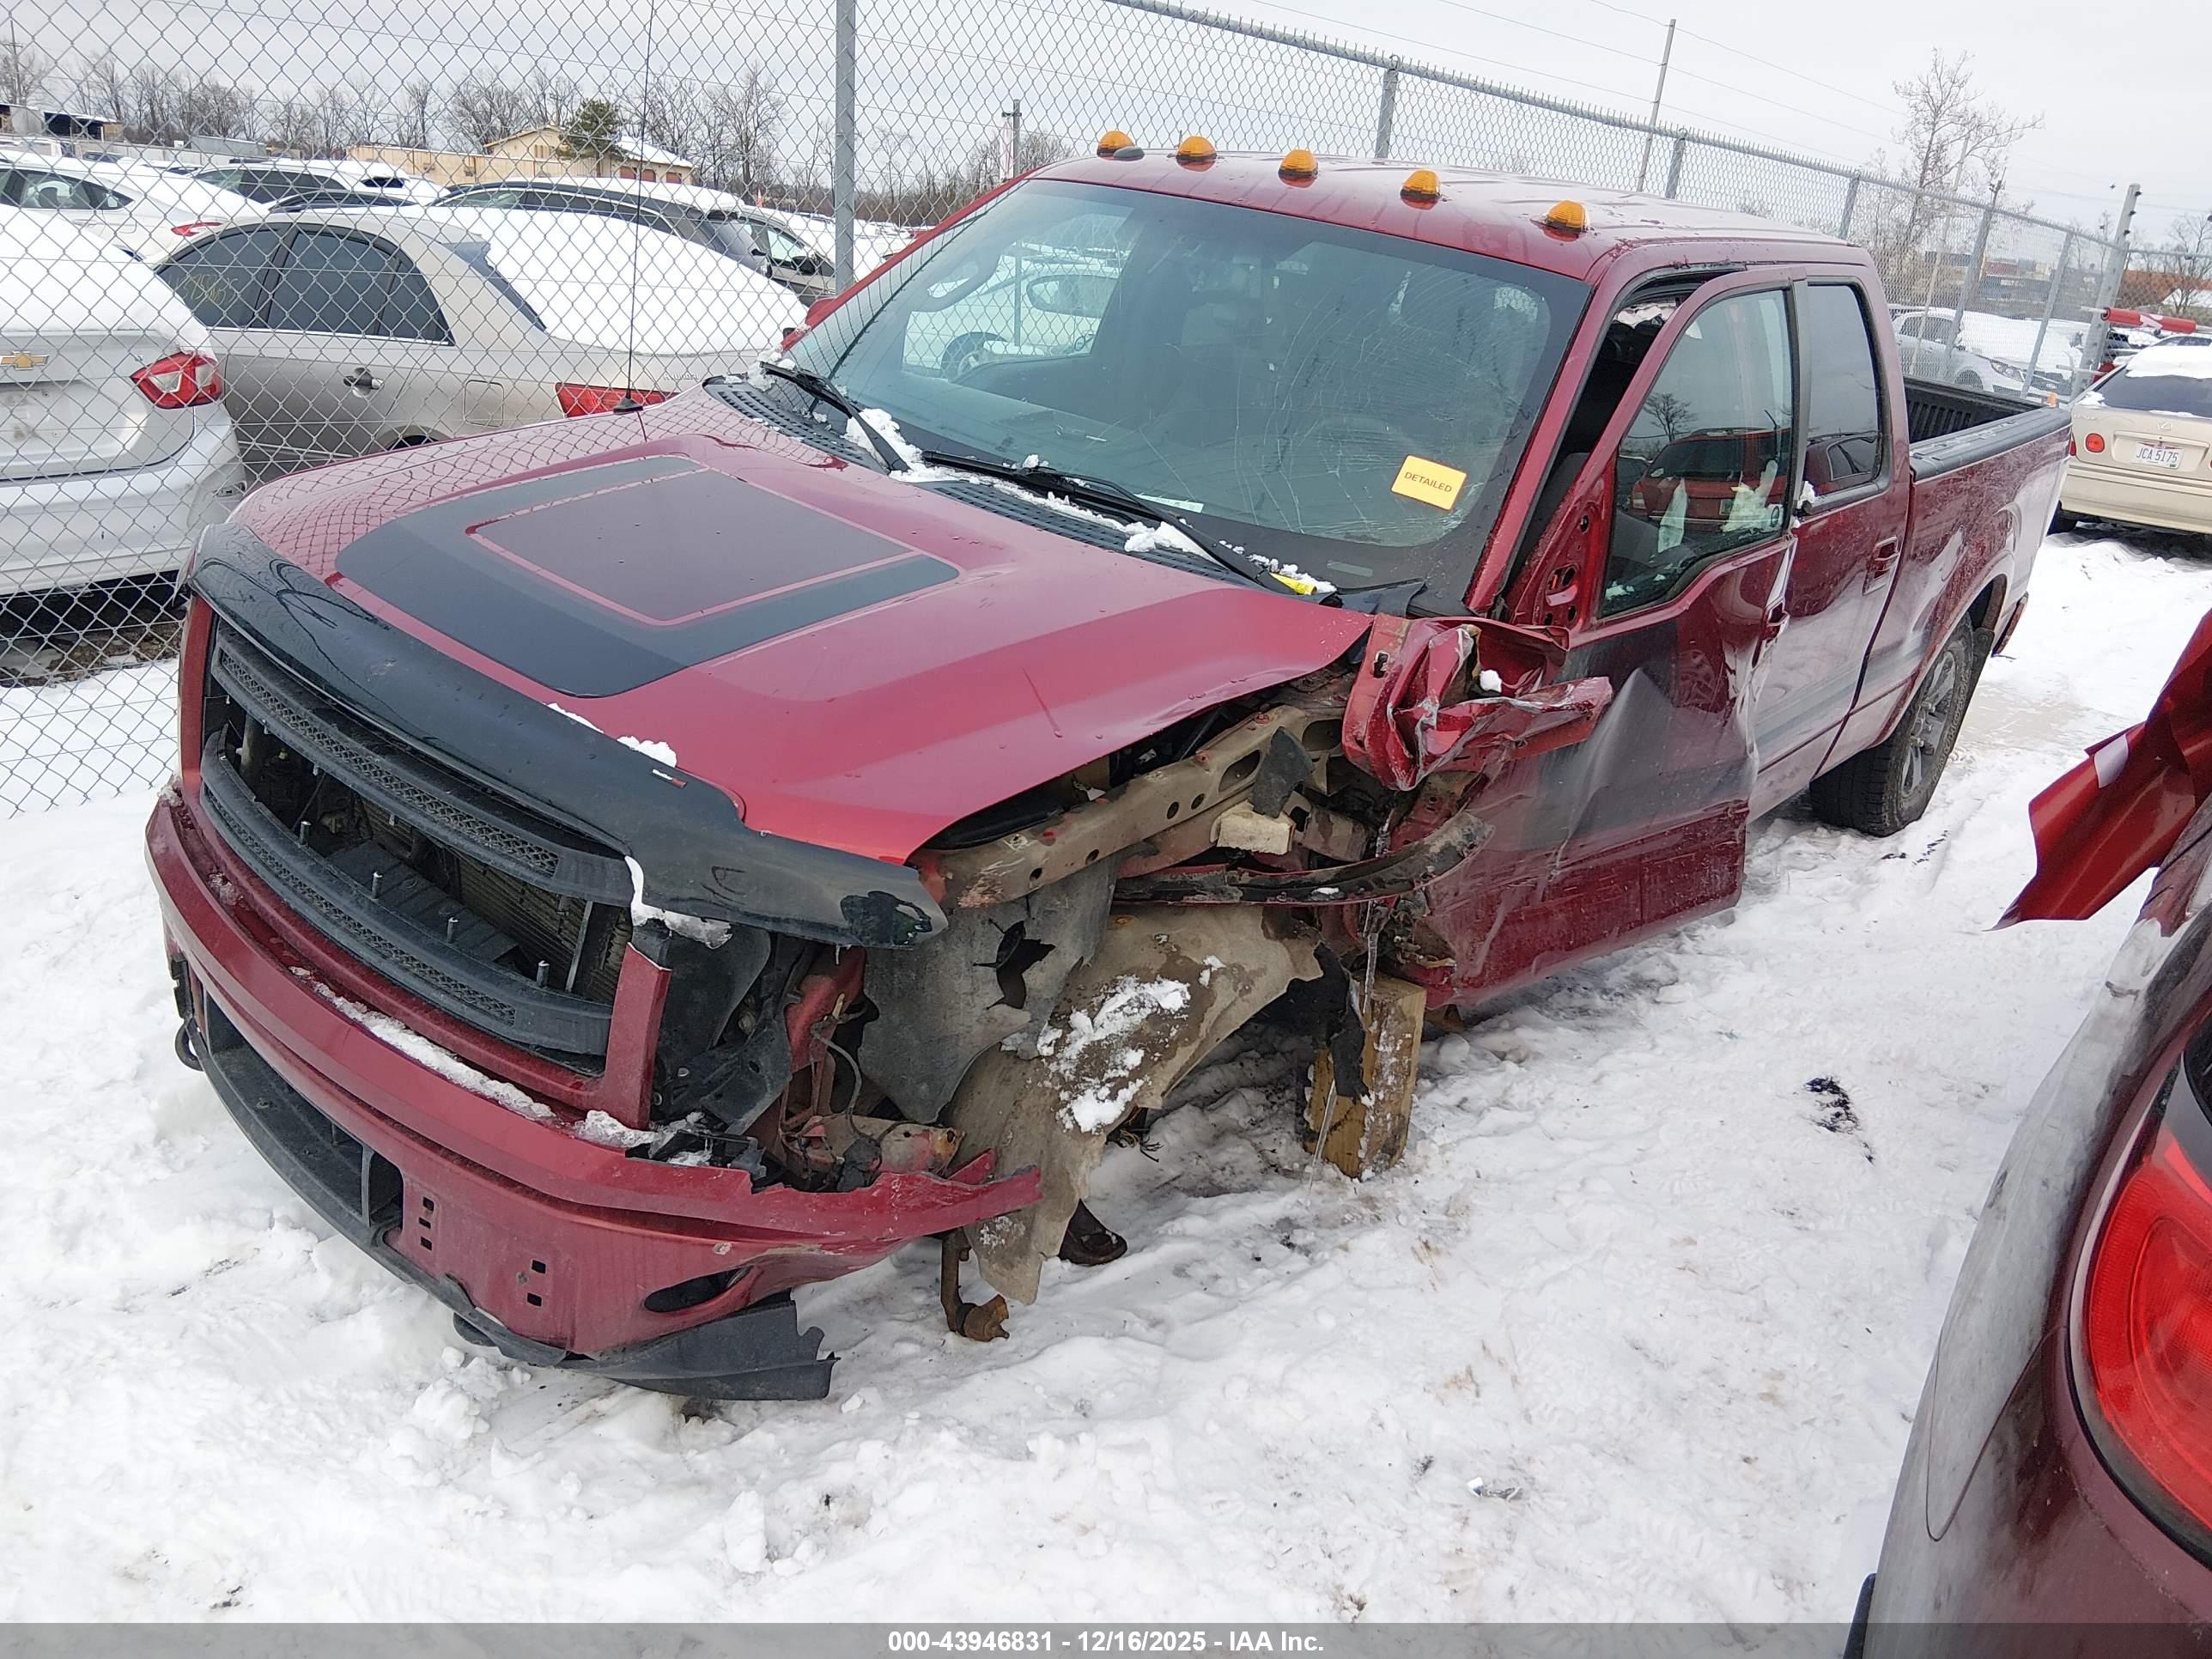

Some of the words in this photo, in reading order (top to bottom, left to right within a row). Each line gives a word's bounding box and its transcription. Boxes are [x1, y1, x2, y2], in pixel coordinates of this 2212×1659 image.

[2136, 447, 2153, 460] JCA
[2155, 450, 2179, 463] 5175
[1404, 471, 1453, 493] DETAILED
